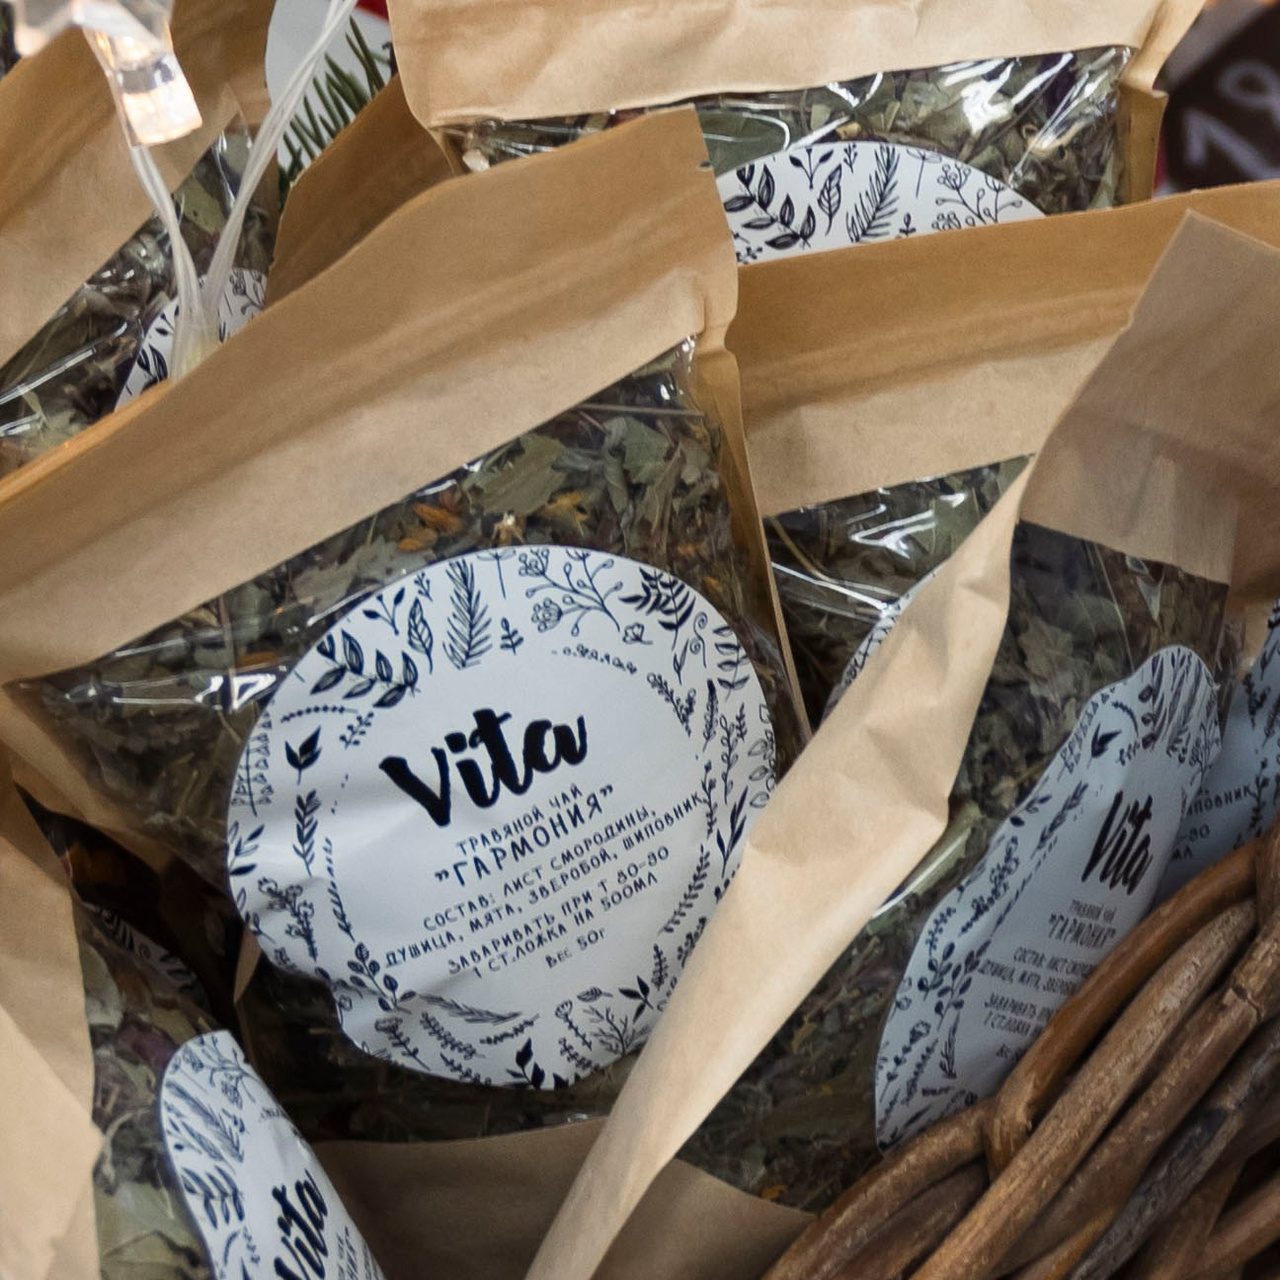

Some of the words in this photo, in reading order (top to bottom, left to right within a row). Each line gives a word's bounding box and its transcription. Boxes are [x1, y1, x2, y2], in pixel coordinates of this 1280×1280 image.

[379, 708, 588, 827] Vita
[456, 804, 545, 856] ТРАВЯНОЙ
[549, 782, 582, 810] ЧАЙ
[385, 930, 464, 969] ДУШИЦА,
[469, 903, 523, 933] МЯТА,
[528, 846, 618, 905] ЗВЕРОБОЙ,
[622, 791, 703, 851] ШИПОВНИК
[423, 893, 496, 931] СОСТАВ:
[503, 865, 542, 897] ЛИСТ
[550, 805, 656, 871] СМОРОДИНЫ,
[1080, 789, 1155, 896] Vita
[448, 912, 555, 974] ЗАВАРИВАТЬ
[561, 890, 593, 917] ПРИ
[574, 907, 595, 927] НА
